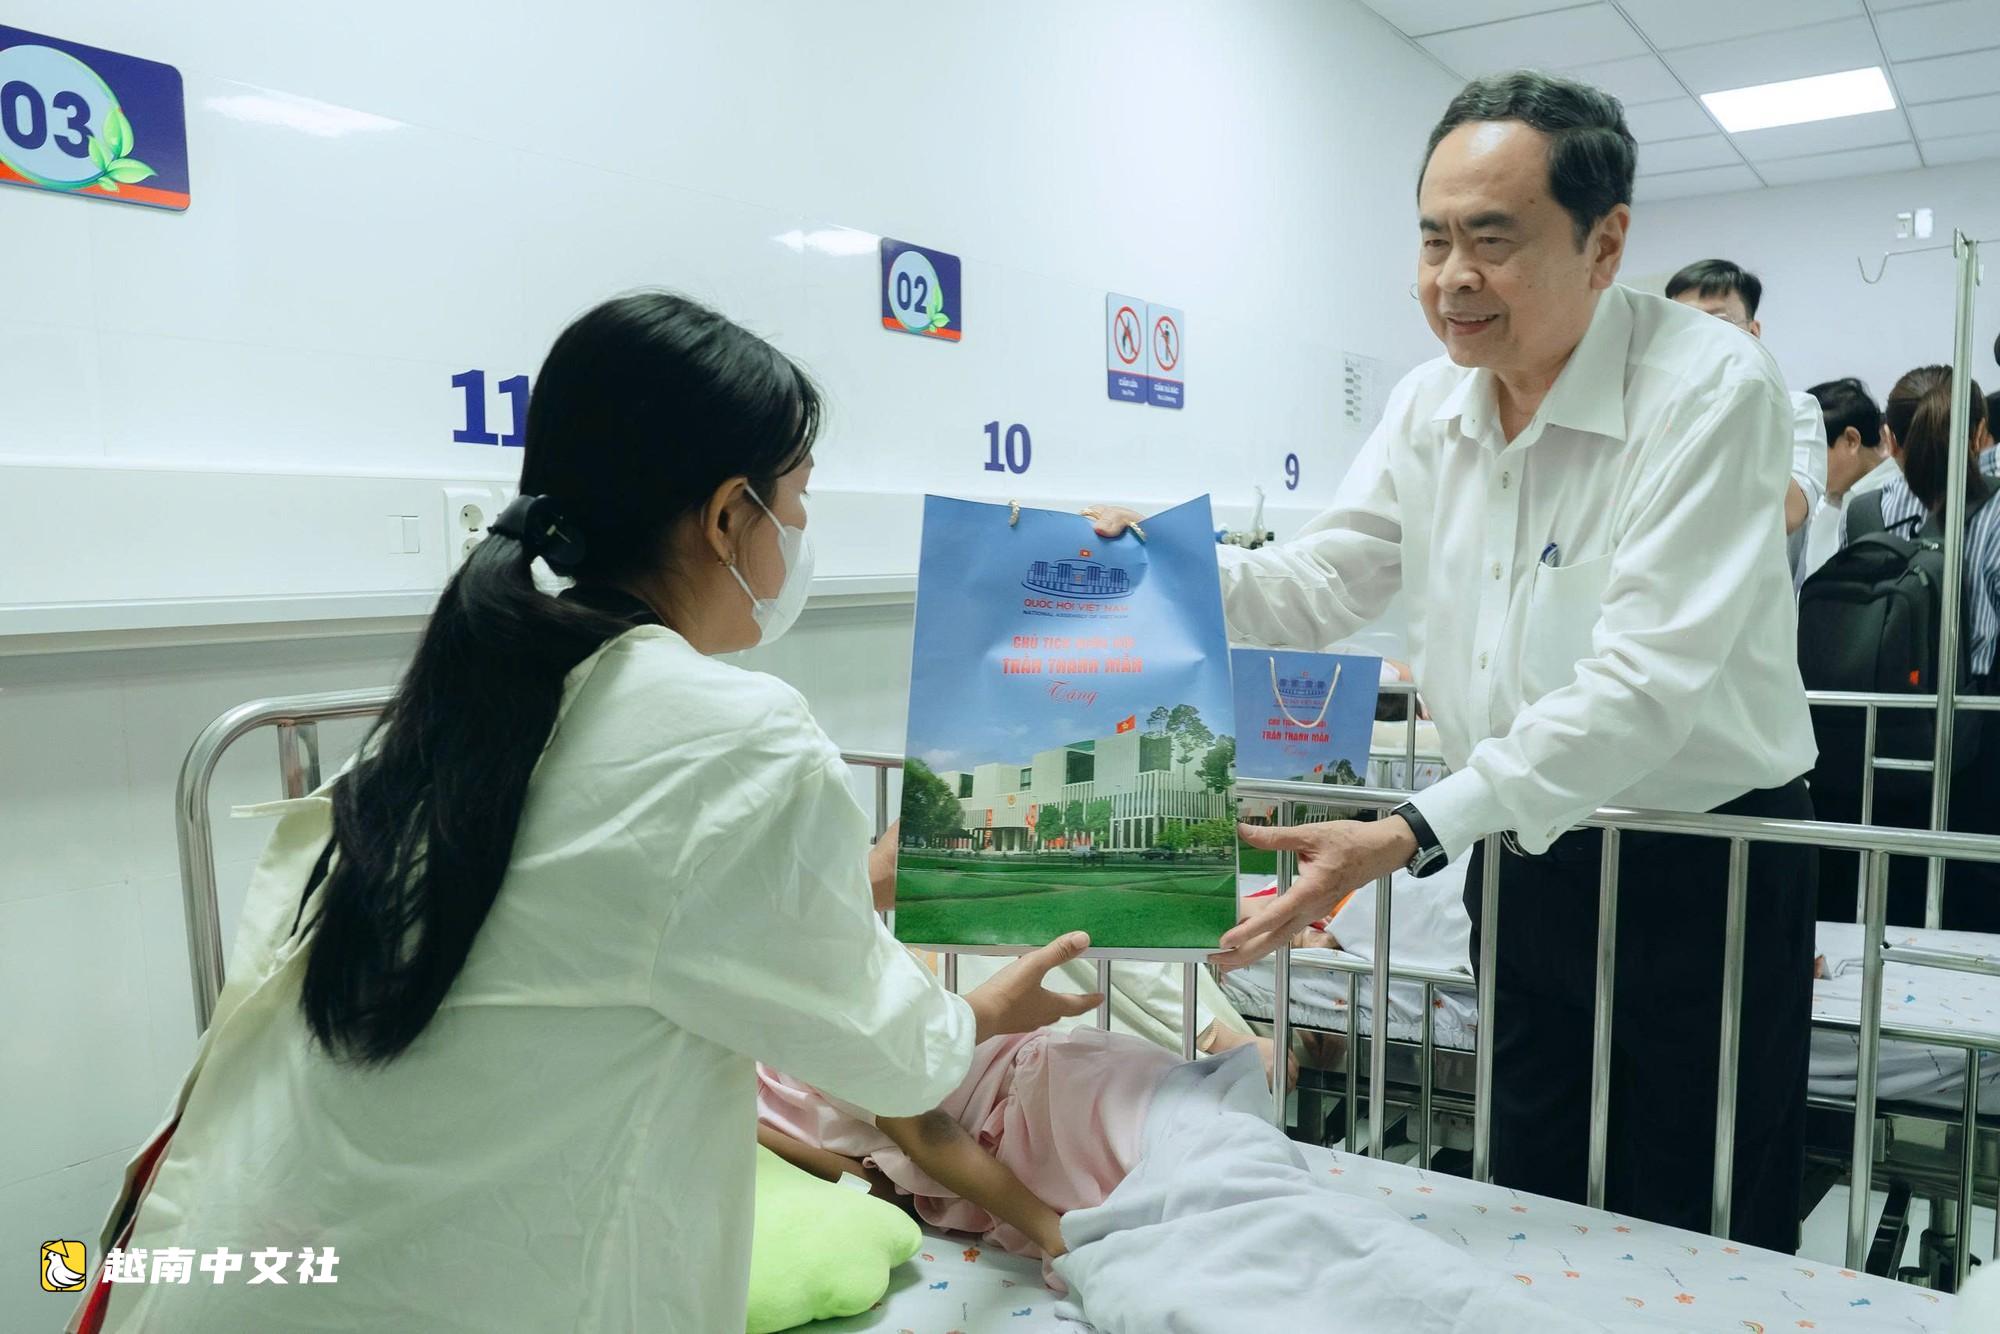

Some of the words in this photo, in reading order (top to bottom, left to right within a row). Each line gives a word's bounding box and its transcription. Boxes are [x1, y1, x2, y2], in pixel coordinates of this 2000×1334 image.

[1, 80, 95, 159] 03
[897, 271, 928, 315] 02
[451, 369, 530, 448] 11
[984, 420, 1031, 475] 10
[1285, 453, 1299, 490] 9
[1048, 657, 1099, 674] THANH
